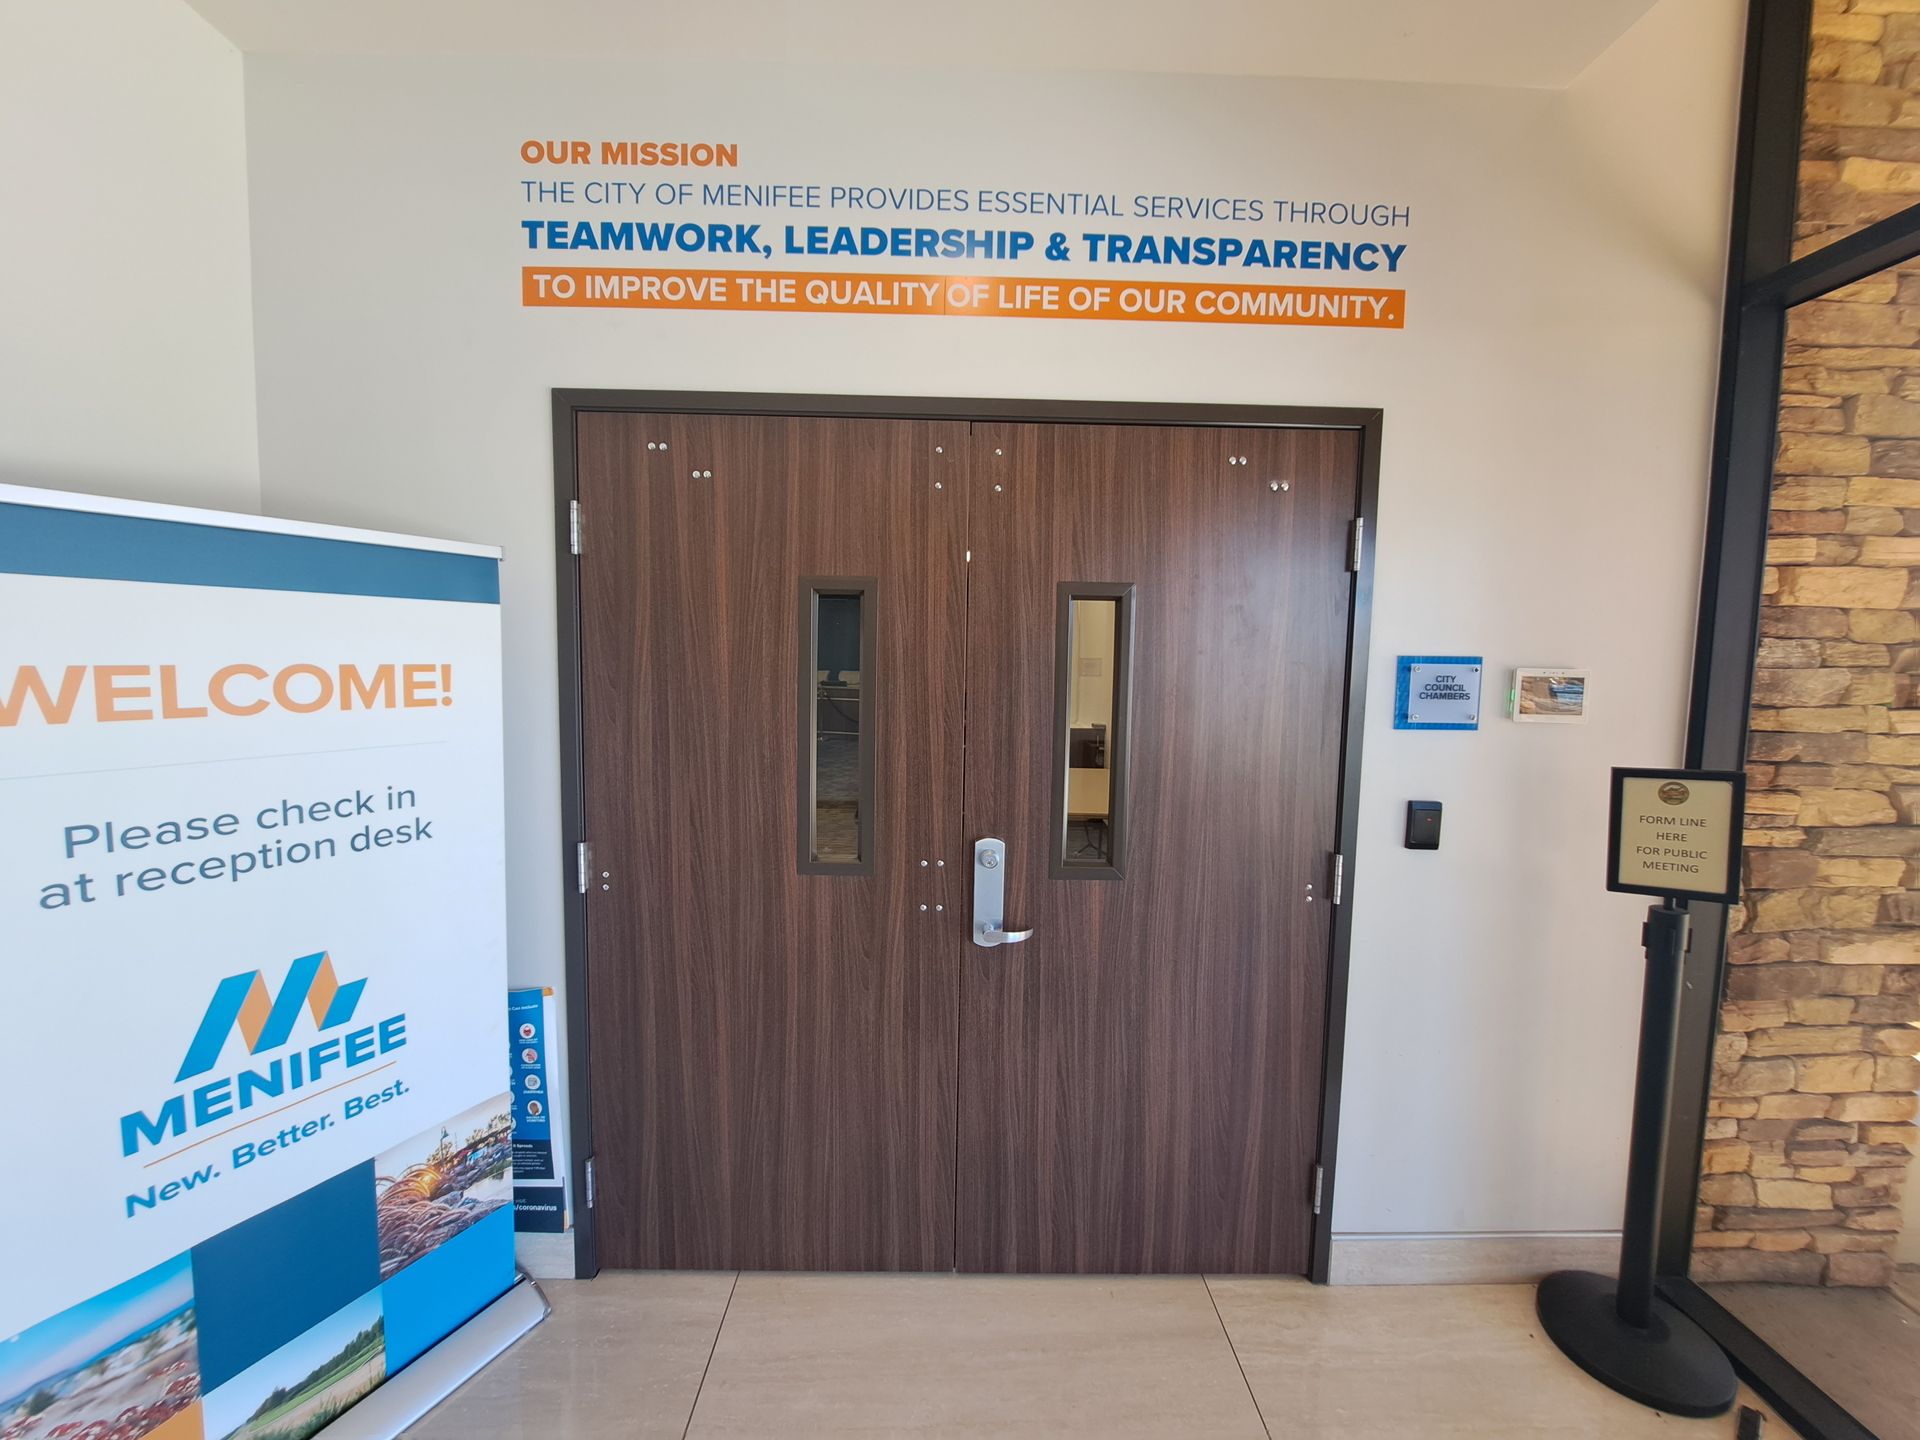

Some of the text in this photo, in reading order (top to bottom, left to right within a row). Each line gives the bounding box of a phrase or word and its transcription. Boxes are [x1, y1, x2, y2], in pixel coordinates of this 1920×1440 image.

[520, 140, 738, 167] OUR MISSION
[521, 181, 1410, 228] THE CITY OF MENIFEE PROVIDES ESSENTIAL SERVICES THROUGH
[521, 220, 1407, 272] TEAMWORK, LEADERSHIP & TRANSPARENCY
[533, 274, 1395, 321] TO IMPROVE THE QUALITY OF LIFE OF OUR COMMUNITY.
[0, 663, 453, 727] WELCOME!
[1419, 692, 1471, 700] CHAMBERS
[1424, 684, 1466, 692] COUNCIL
[1435, 675, 1456, 683] CITY
[63, 785, 416, 859] Please check in
[1639, 815, 1707, 828] FORM LINE
[1656, 832, 1688, 842] HERE
[38, 816, 433, 910] at reception desk
[1636, 846, 1708, 859] FOR PUBLIC
[1642, 861, 1699, 873] MEETING
[120, 1013, 407, 1157] MENIFEE
[126, 1079, 410, 1218] New. Better. Best.
